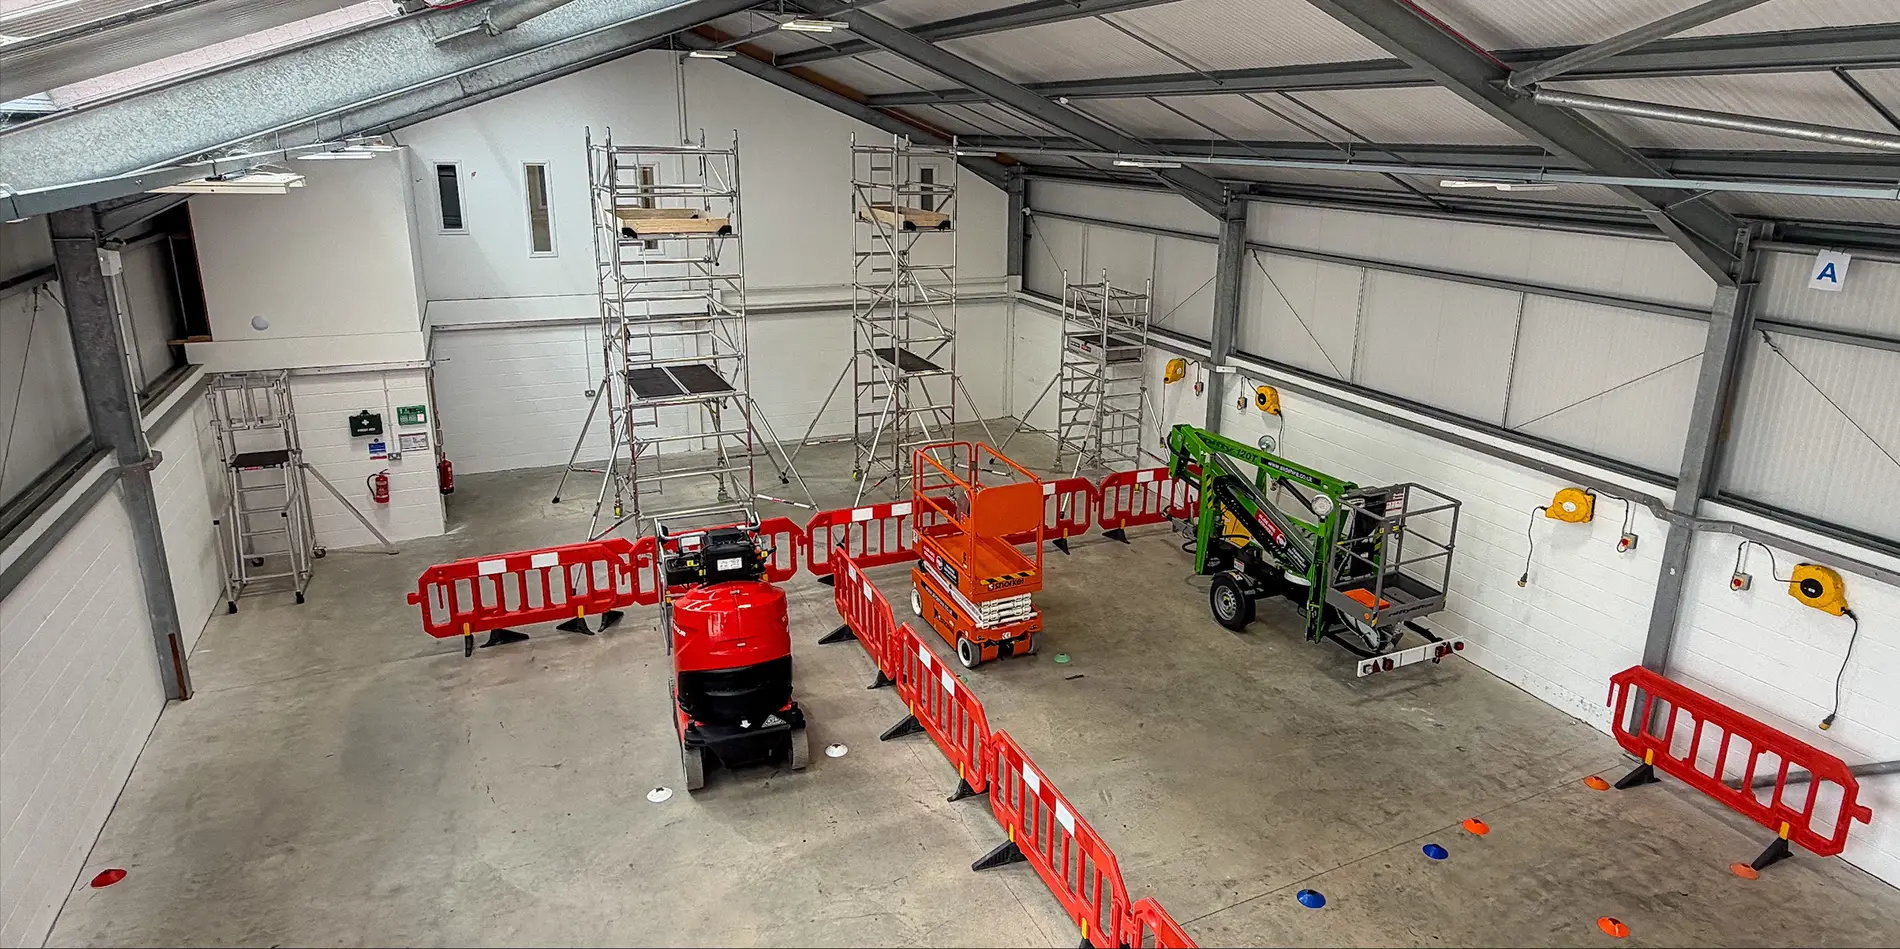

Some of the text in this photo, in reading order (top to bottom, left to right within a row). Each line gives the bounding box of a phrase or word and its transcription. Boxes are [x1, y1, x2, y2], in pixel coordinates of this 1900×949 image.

[1816, 262, 1837, 283] A
[1236, 448, 1258, 461] 120T
[995, 578, 1024, 589] snorkel
